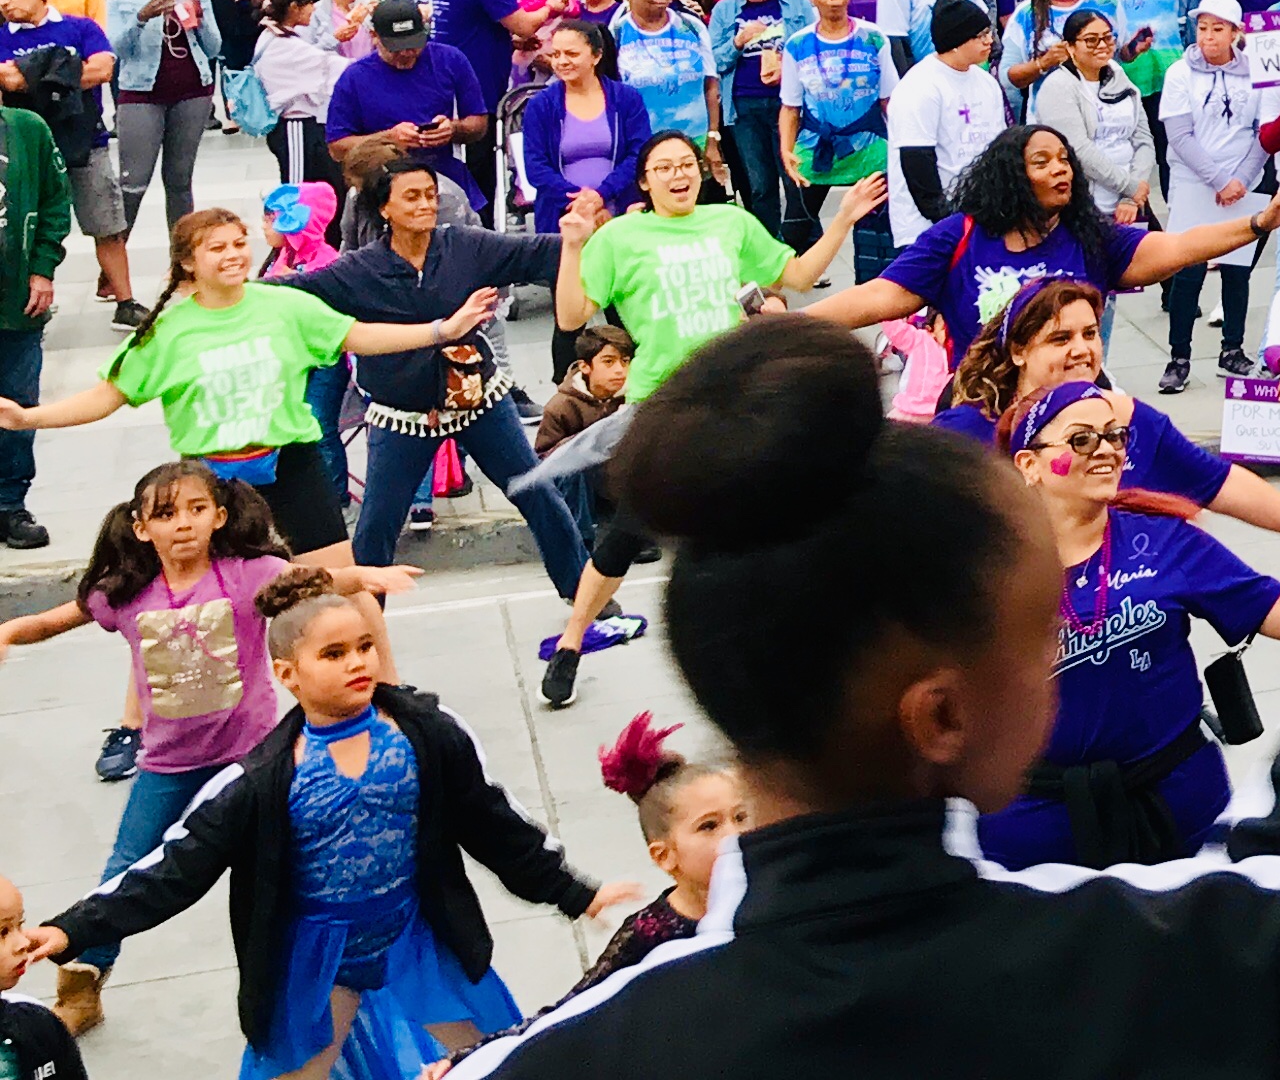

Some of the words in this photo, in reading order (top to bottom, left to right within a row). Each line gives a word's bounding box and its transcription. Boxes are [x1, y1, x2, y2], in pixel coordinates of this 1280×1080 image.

[1254, 34, 1280, 53] FOR
[656, 236, 726, 265] WALK
[655, 265, 684, 290] TO
[687, 257, 733, 284] END
[676, 308, 730, 340] NOW
[198, 335, 273, 373] WALK
[198, 371, 234, 397] TO
[234, 359, 283, 388] END
[1253, 384, 1278, 398] WHY
[192, 381, 286, 429] LUPUS
[1230, 404, 1261, 423] POR
[217, 411, 274, 451] NOW
[1235, 425, 1260, 439] QUE
[1257, 438, 1275, 452] SU
[1129, 648, 1151, 672] LA
